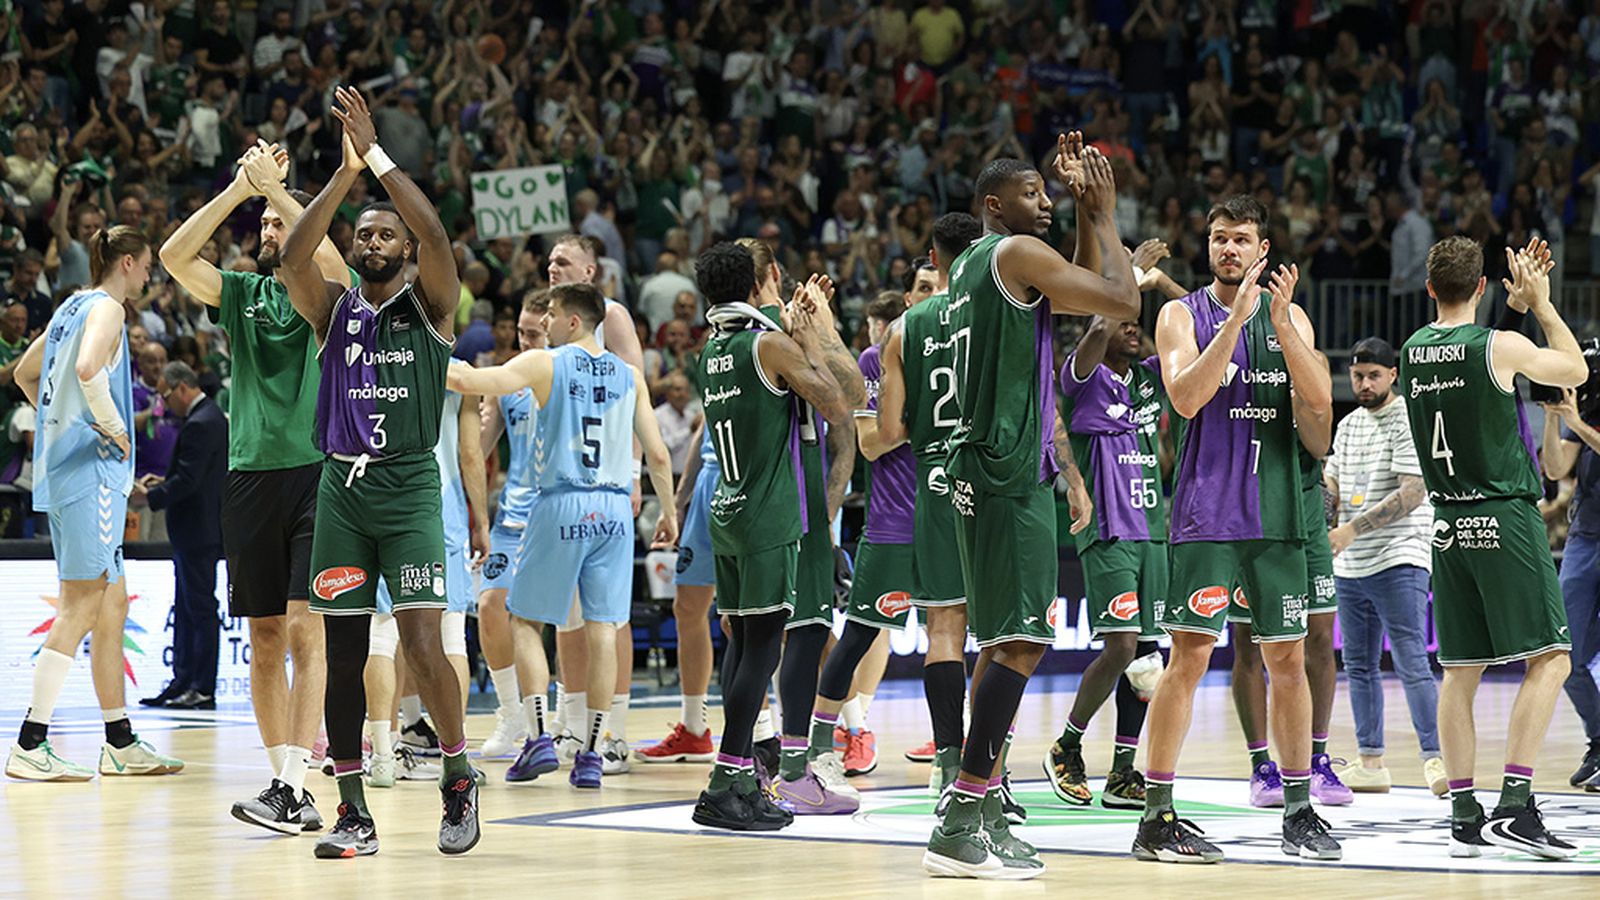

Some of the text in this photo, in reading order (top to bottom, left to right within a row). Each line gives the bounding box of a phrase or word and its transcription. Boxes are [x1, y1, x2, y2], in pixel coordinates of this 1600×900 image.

[475, 199, 565, 238] DYLAN
[362, 348, 415, 366] Unicaja
[1408, 344, 1466, 364] KALINOSKI
[347, 383, 409, 403] málaga
[1241, 368, 1287, 387] Unicaja
[929, 366, 959, 428] 2
[368, 413, 387, 449] 3
[581, 416, 602, 469] 5
[1431, 411, 1454, 477] 4
[714, 418, 741, 482] 11
[1251, 439, 1261, 475] 7
[1130, 478, 1157, 509] 55
[560, 520, 626, 541] LEBANZA
[1455, 516, 1500, 529] COSTA
[1476, 529, 1500, 539] SOL
